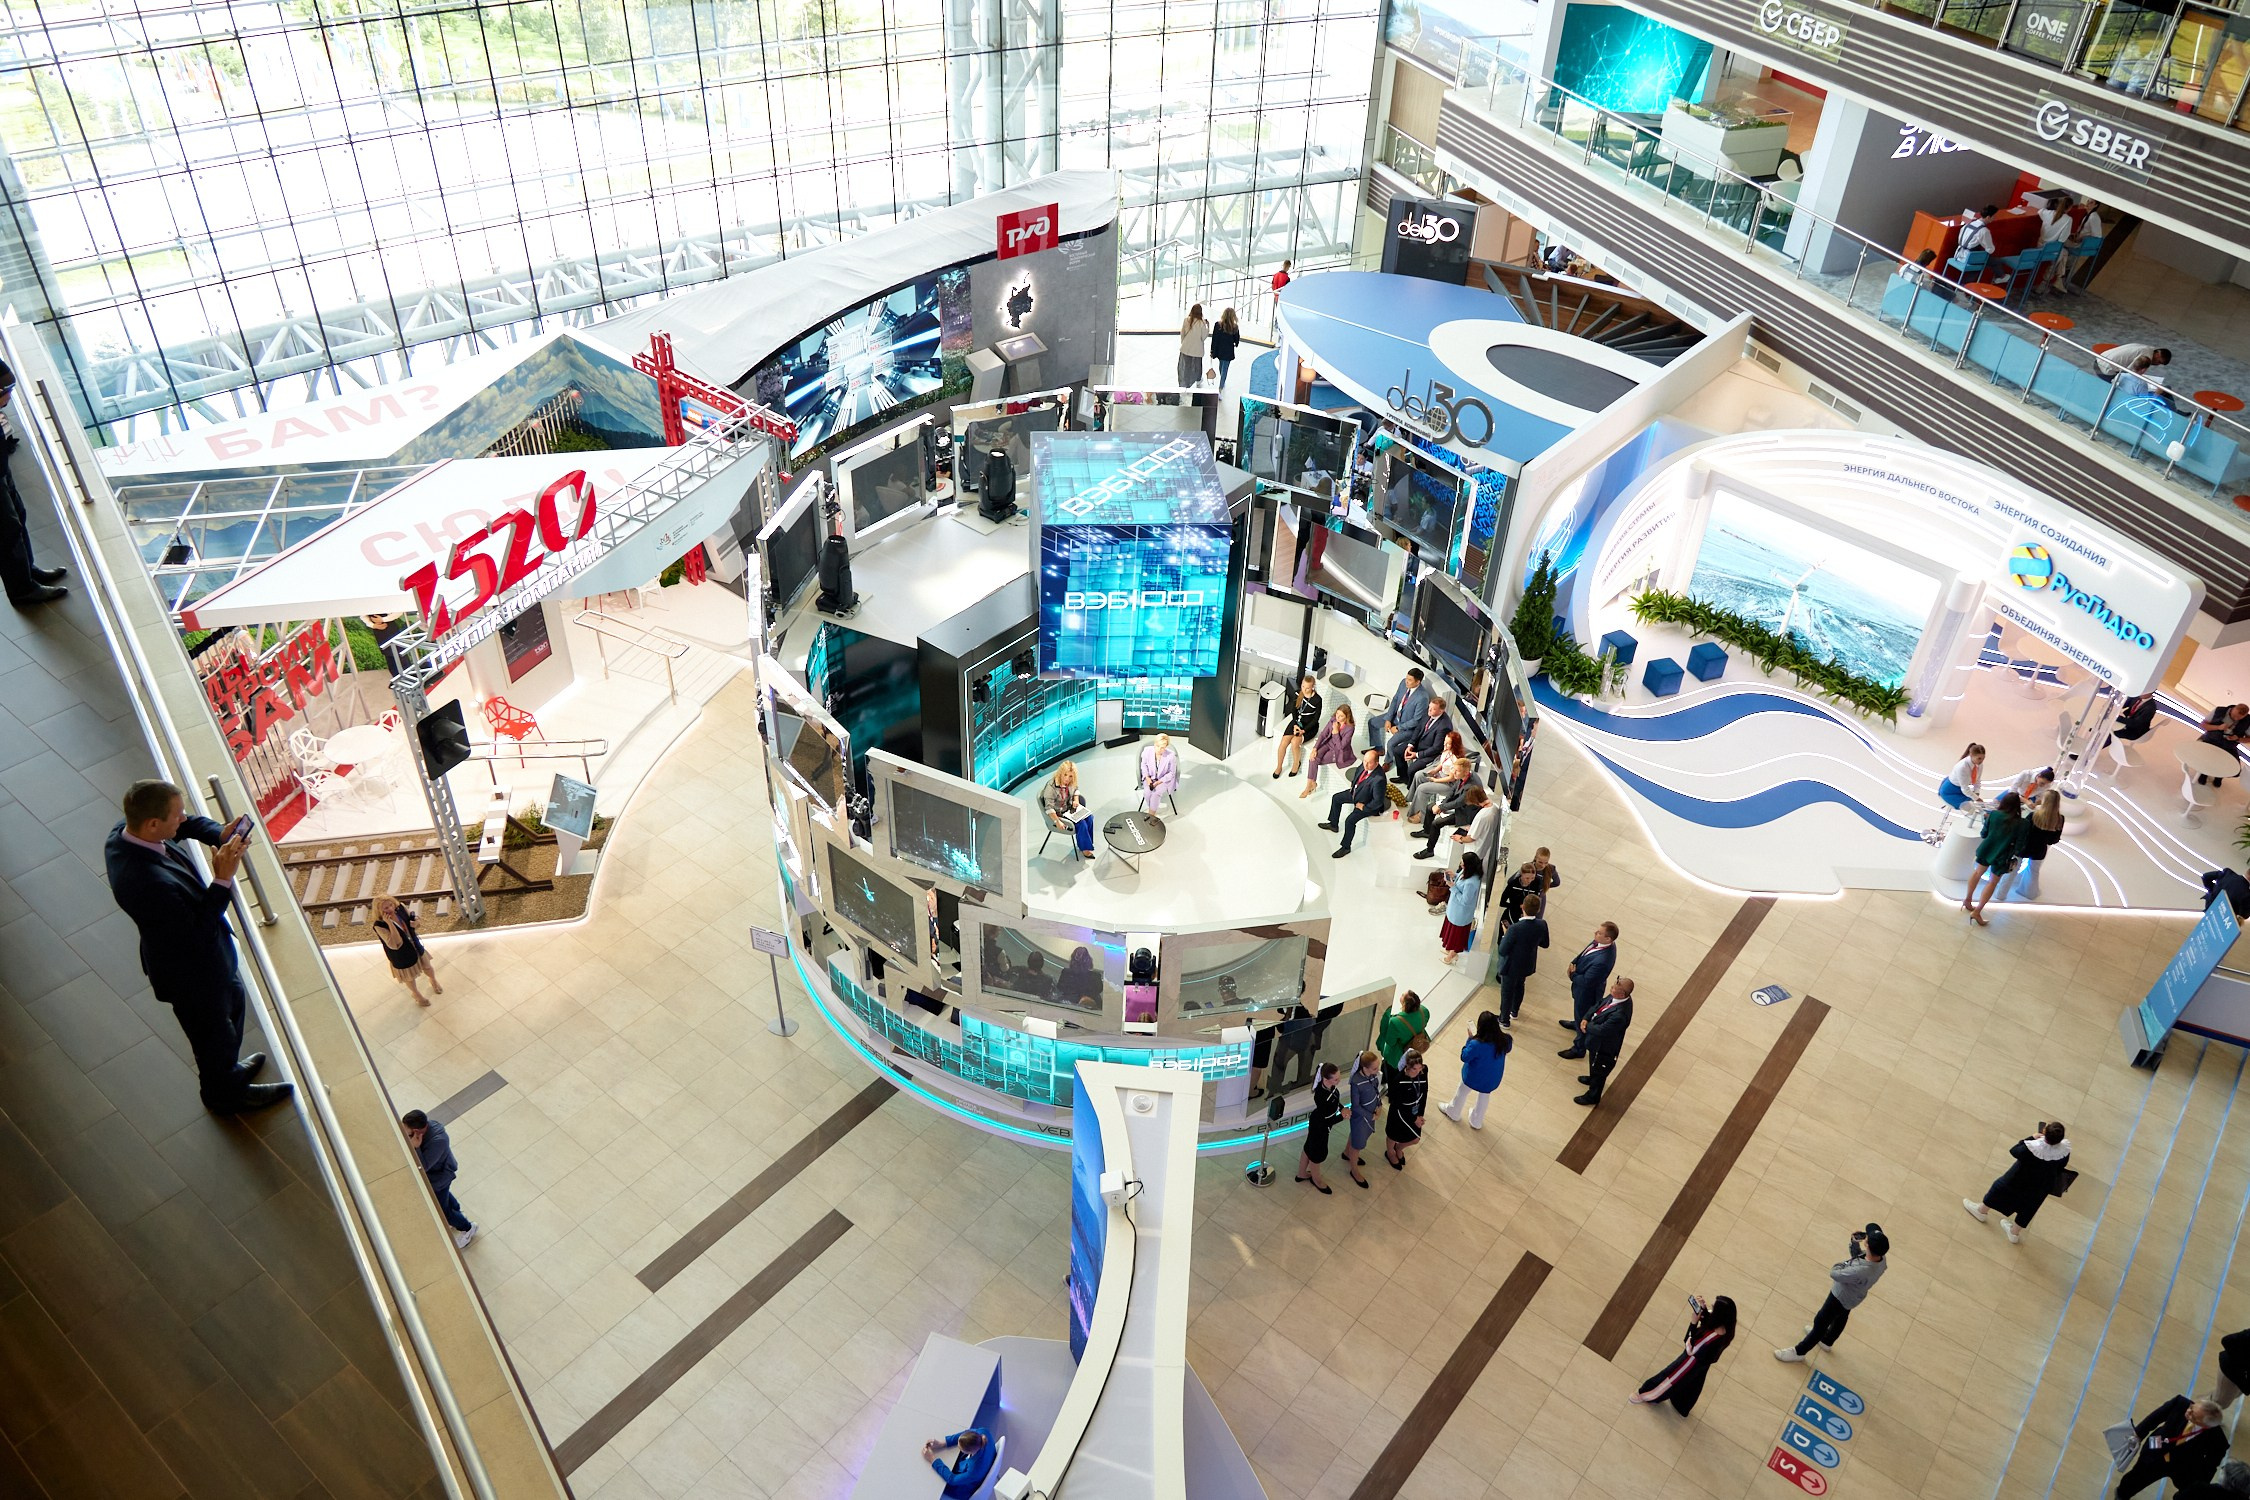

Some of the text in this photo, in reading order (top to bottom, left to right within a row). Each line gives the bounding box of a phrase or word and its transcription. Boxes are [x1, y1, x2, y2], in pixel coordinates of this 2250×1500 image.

[1787, 12, 1840, 48] СБЕР
[2025, 27, 2064, 44] COFFEE PLACE
[2027, 12, 2068, 38] ONE
[2071, 119, 2150, 169] SBER
[205, 384, 441, 462] БАМ?
[1843, 464, 1980, 516] ЭНЕРГИЯ ДАЛЬНЕГО ВОСТОКА
[1628, 502, 1656, 531] СТРАНЫ
[1993, 500, 2107, 568] ЭНЕРГИЯ СОЗИДАНИЯ
[399, 468, 597, 641] 1520
[429, 609, 507, 671] ГРУППА
[506, 539, 605, 620] КОМПАНИЙ
[2050, 571, 2155, 650] РусГидро
[2000, 604, 2113, 681] ОБЪЕДИНЯЯ ЭНЕРГИЮ
[219, 640, 340, 763] БАМ
[1037, 1123, 1071, 1138] VEB
[1818, 1380, 1836, 1395] B
[1805, 1406, 1823, 1421] C
[1793, 1431, 1811, 1448] D
[1780, 1458, 1797, 1475] S
